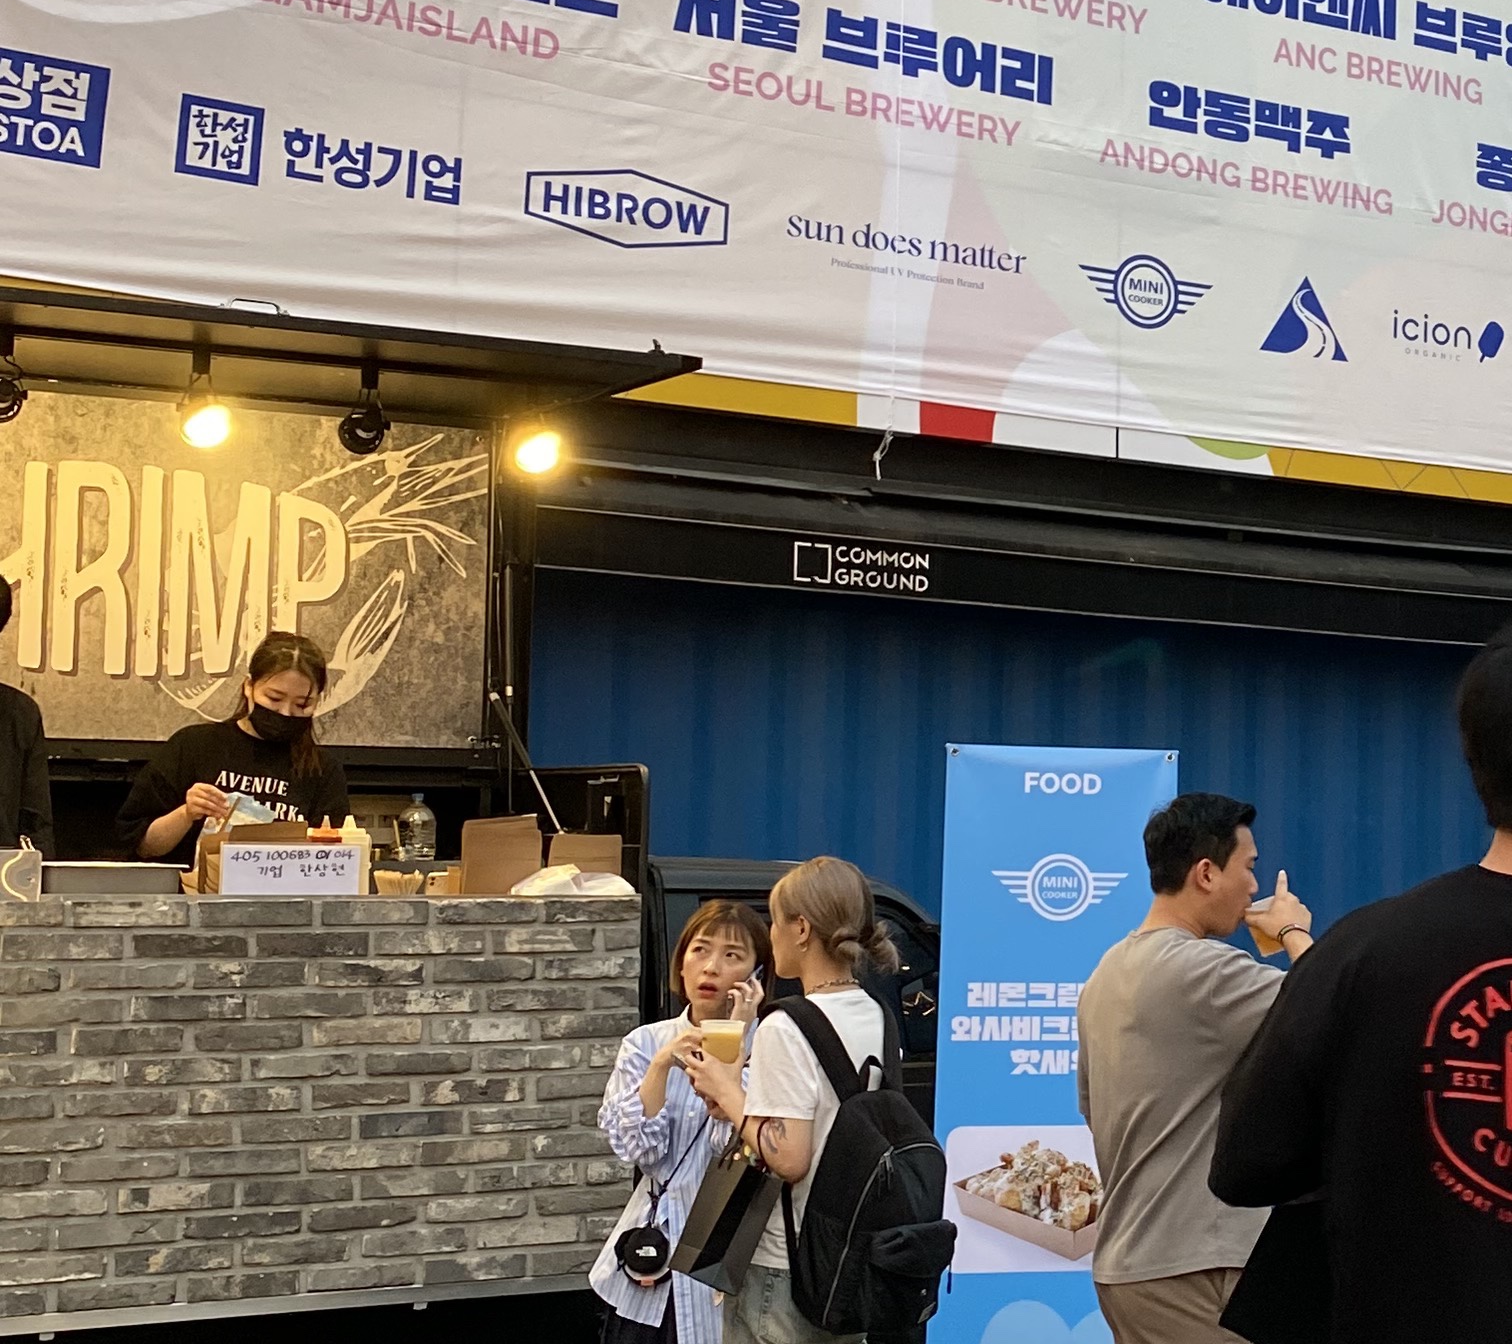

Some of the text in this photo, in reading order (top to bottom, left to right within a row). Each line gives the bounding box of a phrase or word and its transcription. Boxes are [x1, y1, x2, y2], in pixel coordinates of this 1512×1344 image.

[822, 7, 1053, 106] 브루어리
[1273, 38, 1483, 106] ANC BREWING
[707, 62, 1021, 147] SEOUL BREWERY
[1148, 79, 1351, 161] 안동맥주
[283, 126, 462, 205] 한성기업
[1099, 138, 1394, 217] ANDONG BREWING
[542, 180, 710, 236] HIBROW
[787, 213, 1027, 274] sun does matter
[1128, 278, 1164, 295] MINI
[1128, 294, 1164, 307] COOKER
[1392, 309, 1472, 350] icion
[1404, 347, 1462, 362] ORGANIC
[835, 545, 930, 570] COMMON
[834, 568, 929, 592] GROUND
[215, 770, 290, 797] AVENUE
[1024, 772, 1102, 795] FOOD
[1042, 876, 1078, 889] MINI
[1042, 890, 1078, 900] COOKER
[951, 1015, 1078, 1042] 와사비크
